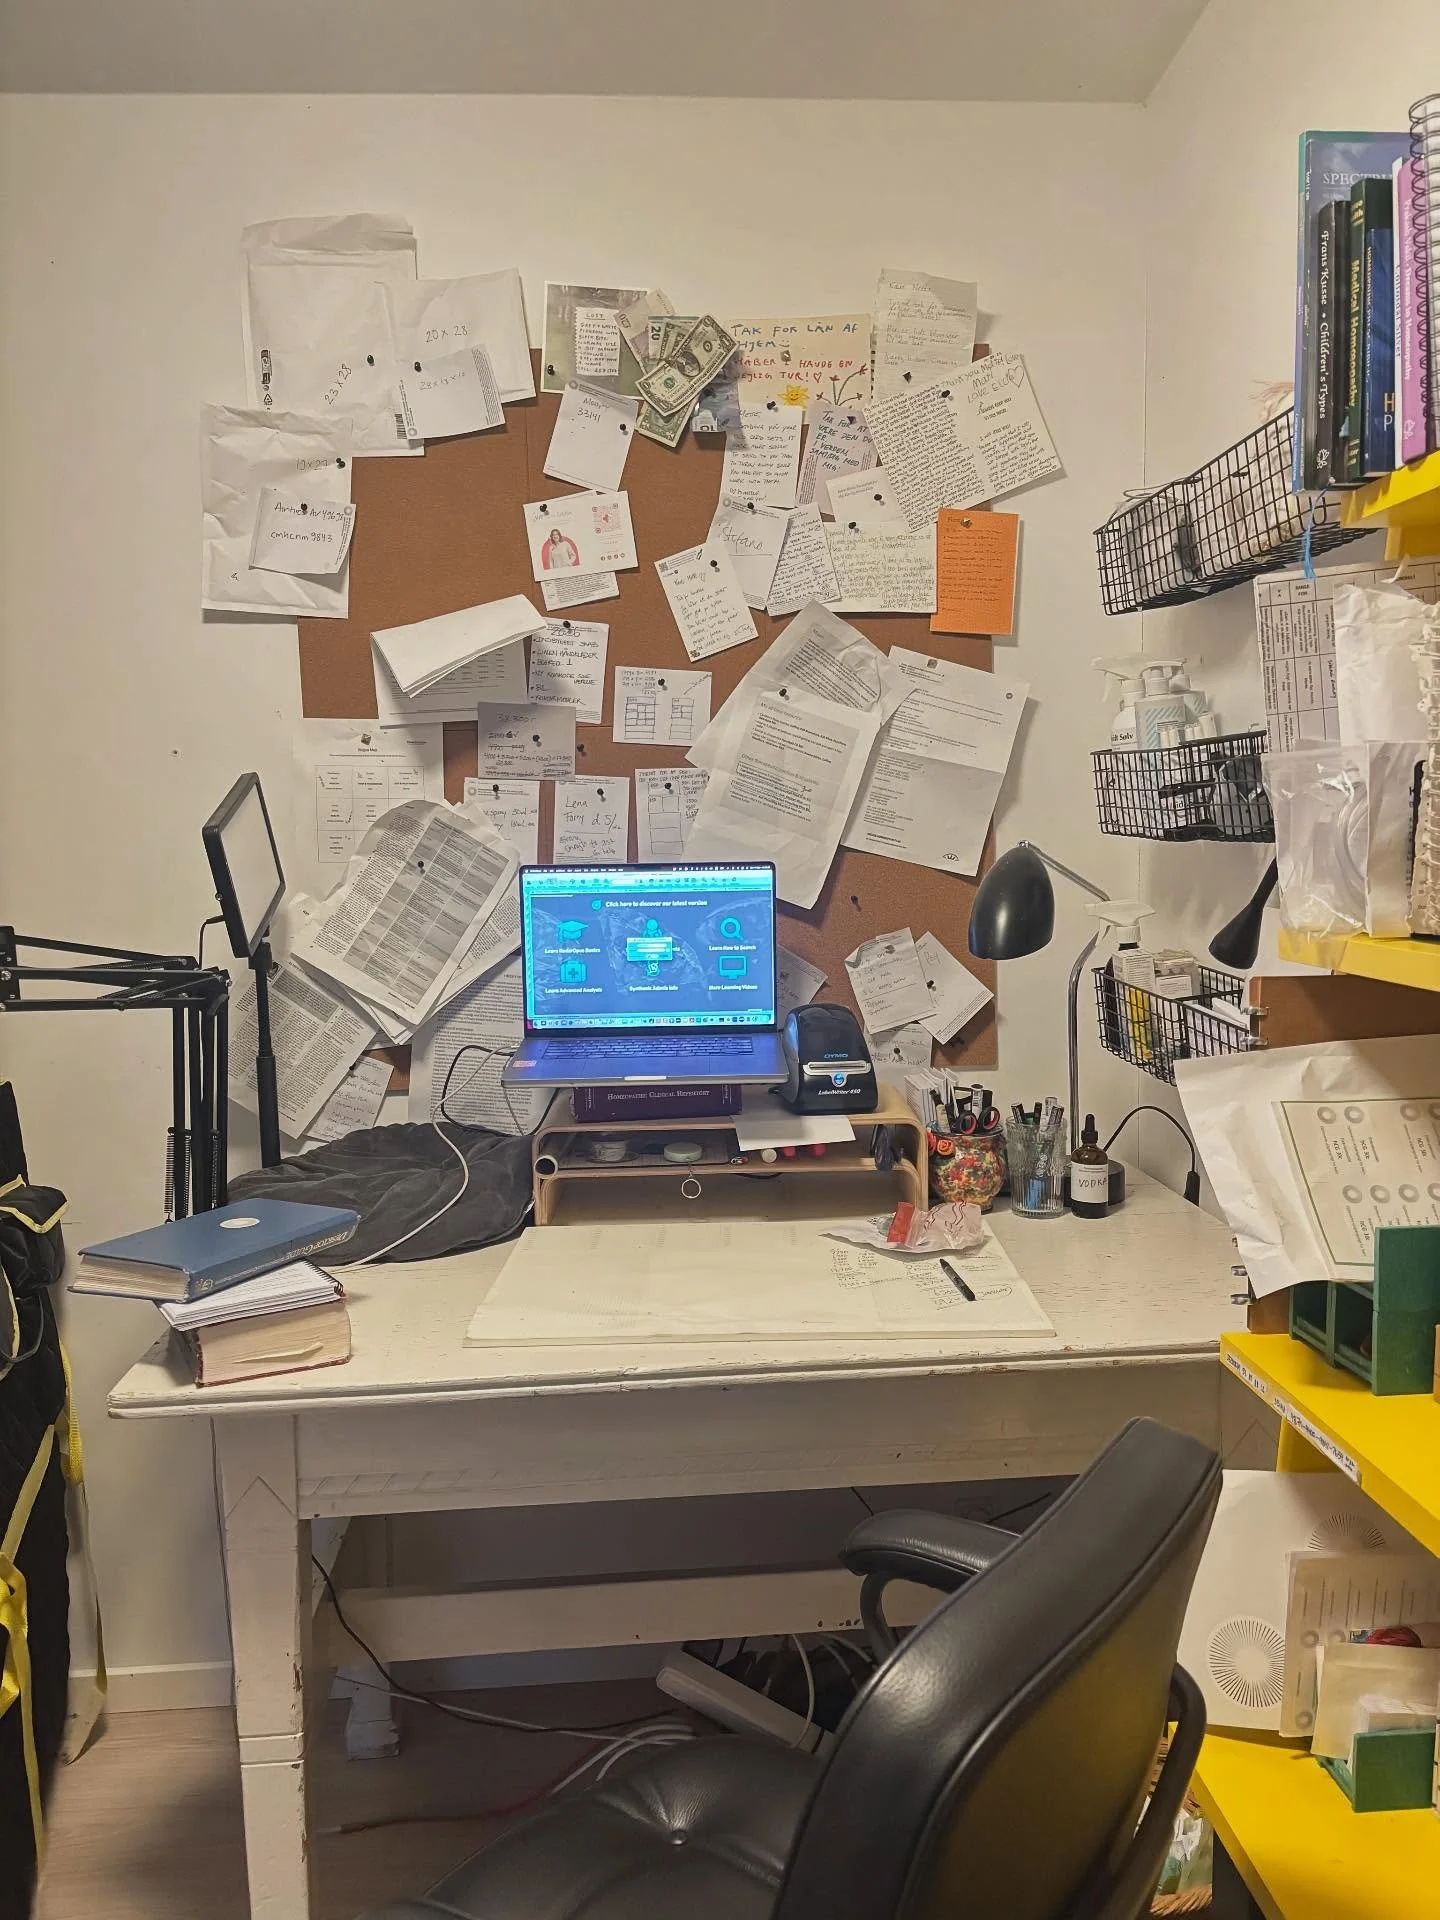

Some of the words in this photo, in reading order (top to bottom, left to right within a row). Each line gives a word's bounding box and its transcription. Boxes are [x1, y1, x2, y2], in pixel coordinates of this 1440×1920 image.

[1320, 230, 1329, 267] Frans
[1320, 269, 1329, 305] Kusse
[1350, 260, 1360, 313] Medical
[731, 324, 761, 337] TAK
[773, 325, 797, 337] FOR
[800, 360, 832, 368] HAVDE
[1319, 322, 1329, 382] Children's
[822, 411, 834, 424] TAK
[1318, 383, 1329, 419] Types
